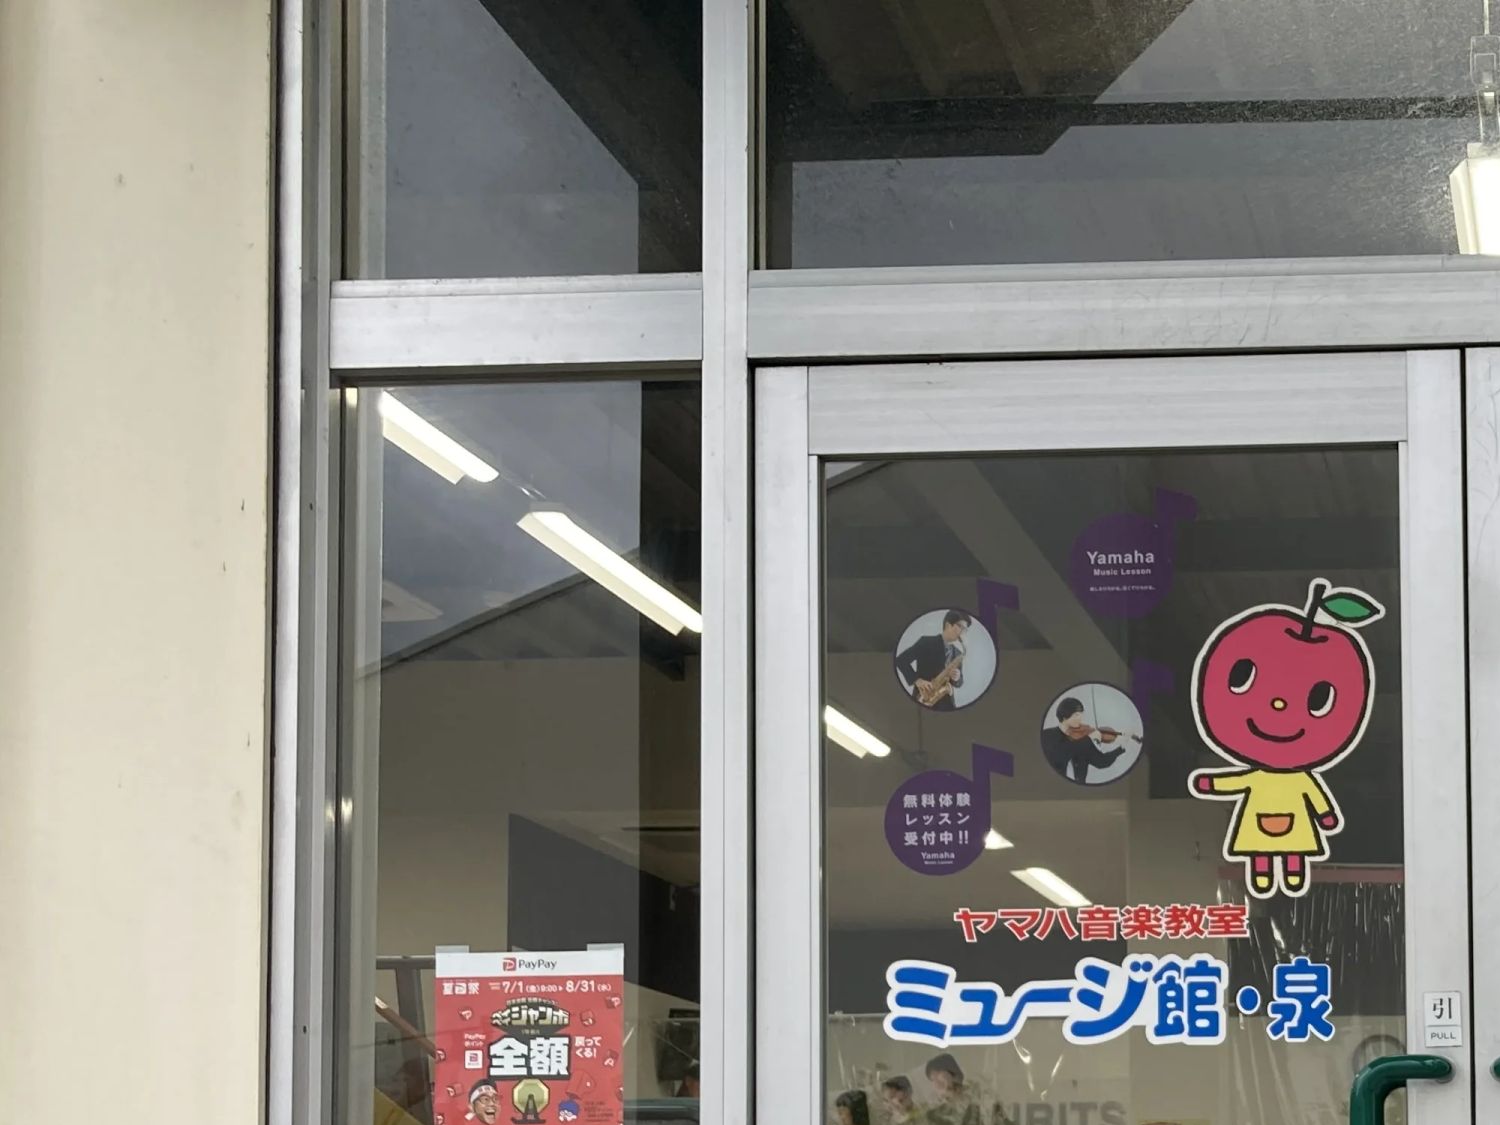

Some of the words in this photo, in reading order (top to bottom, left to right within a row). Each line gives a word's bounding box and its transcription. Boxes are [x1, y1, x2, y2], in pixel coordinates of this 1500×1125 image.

[1086, 550, 1155, 565] Yamaha
[903, 792, 971, 808] 無料体験
[905, 812, 970, 826] レッスン
[921, 851, 956, 859] Yamaha
[953, 903, 1251, 944] ヤマハ音楽教室
[518, 959, 558, 970] PayPay
[884, 953, 1336, 1048] ミュージ館・泉
[1431, 997, 1453, 1020] 引
[1430, 1032, 1457, 1040] PULL
[489, 1035, 570, 1076] 全額
